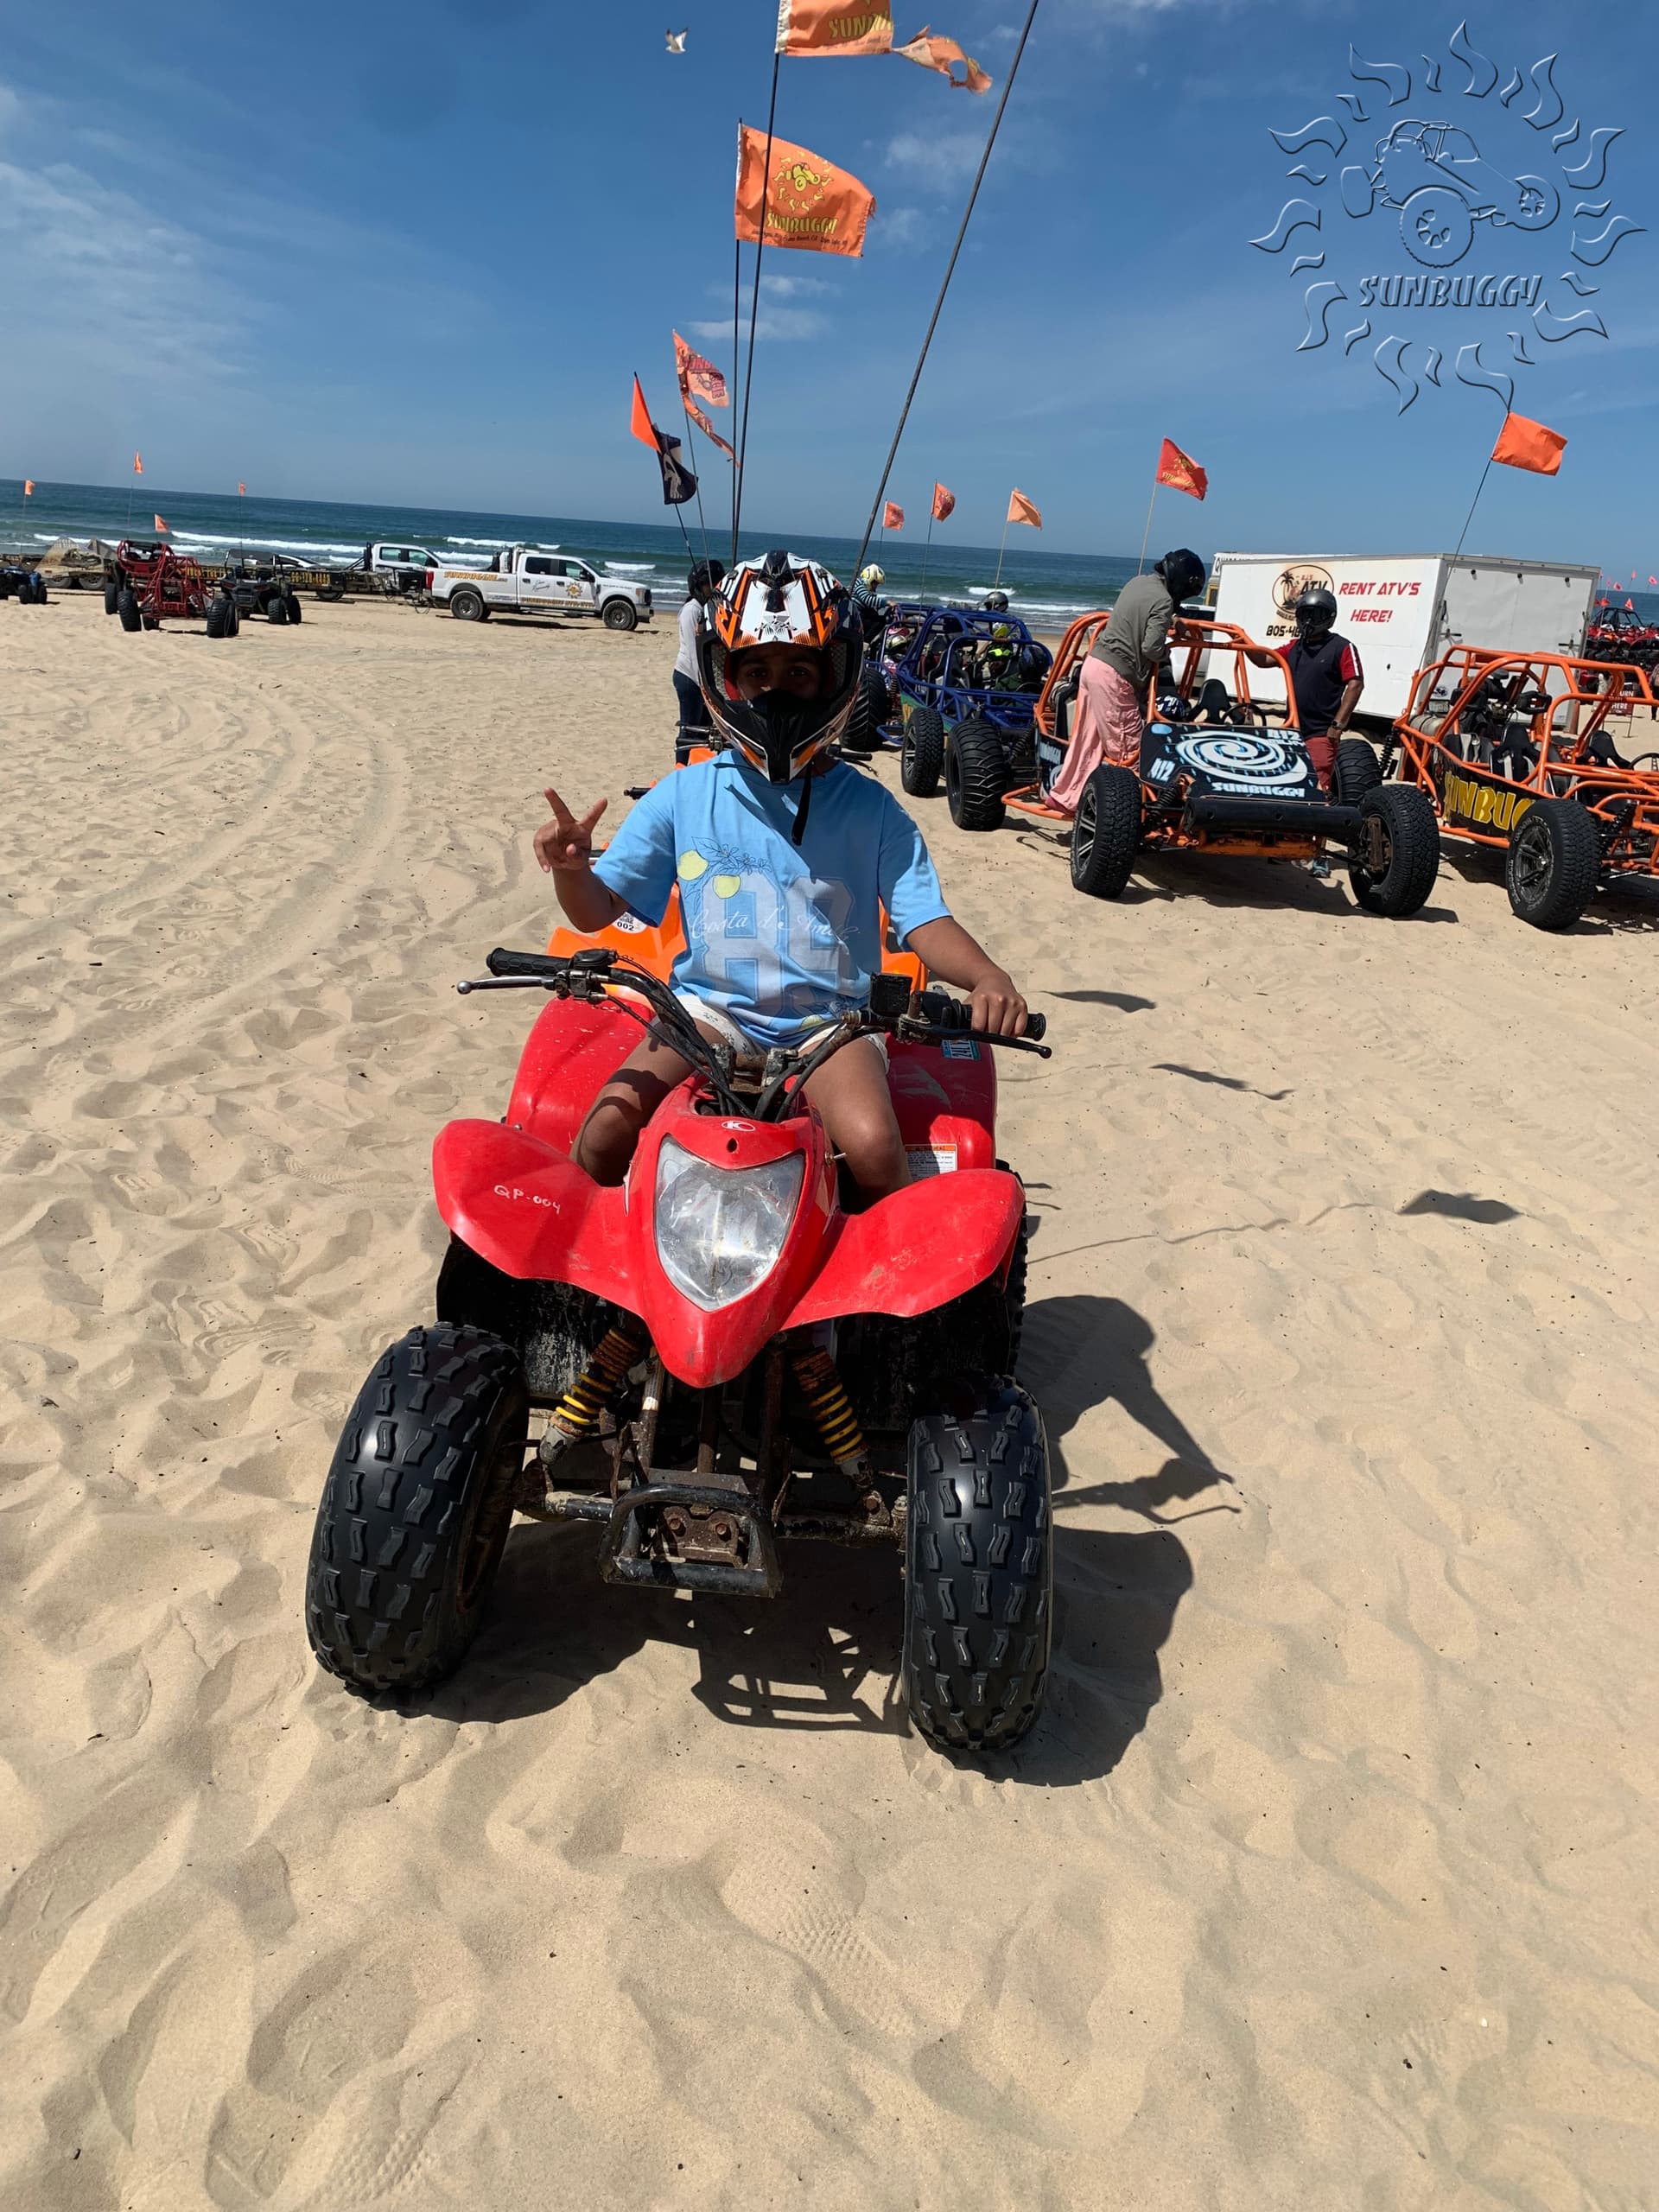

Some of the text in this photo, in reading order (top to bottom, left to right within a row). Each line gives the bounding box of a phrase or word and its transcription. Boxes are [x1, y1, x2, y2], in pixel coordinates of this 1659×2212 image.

[1339, 582, 1421, 596] RENT ATV'S
[1350, 609, 1394, 622] HERE!
[1211, 781, 1306, 798] SUNBUGGY
[617, 921, 634, 931] 002
